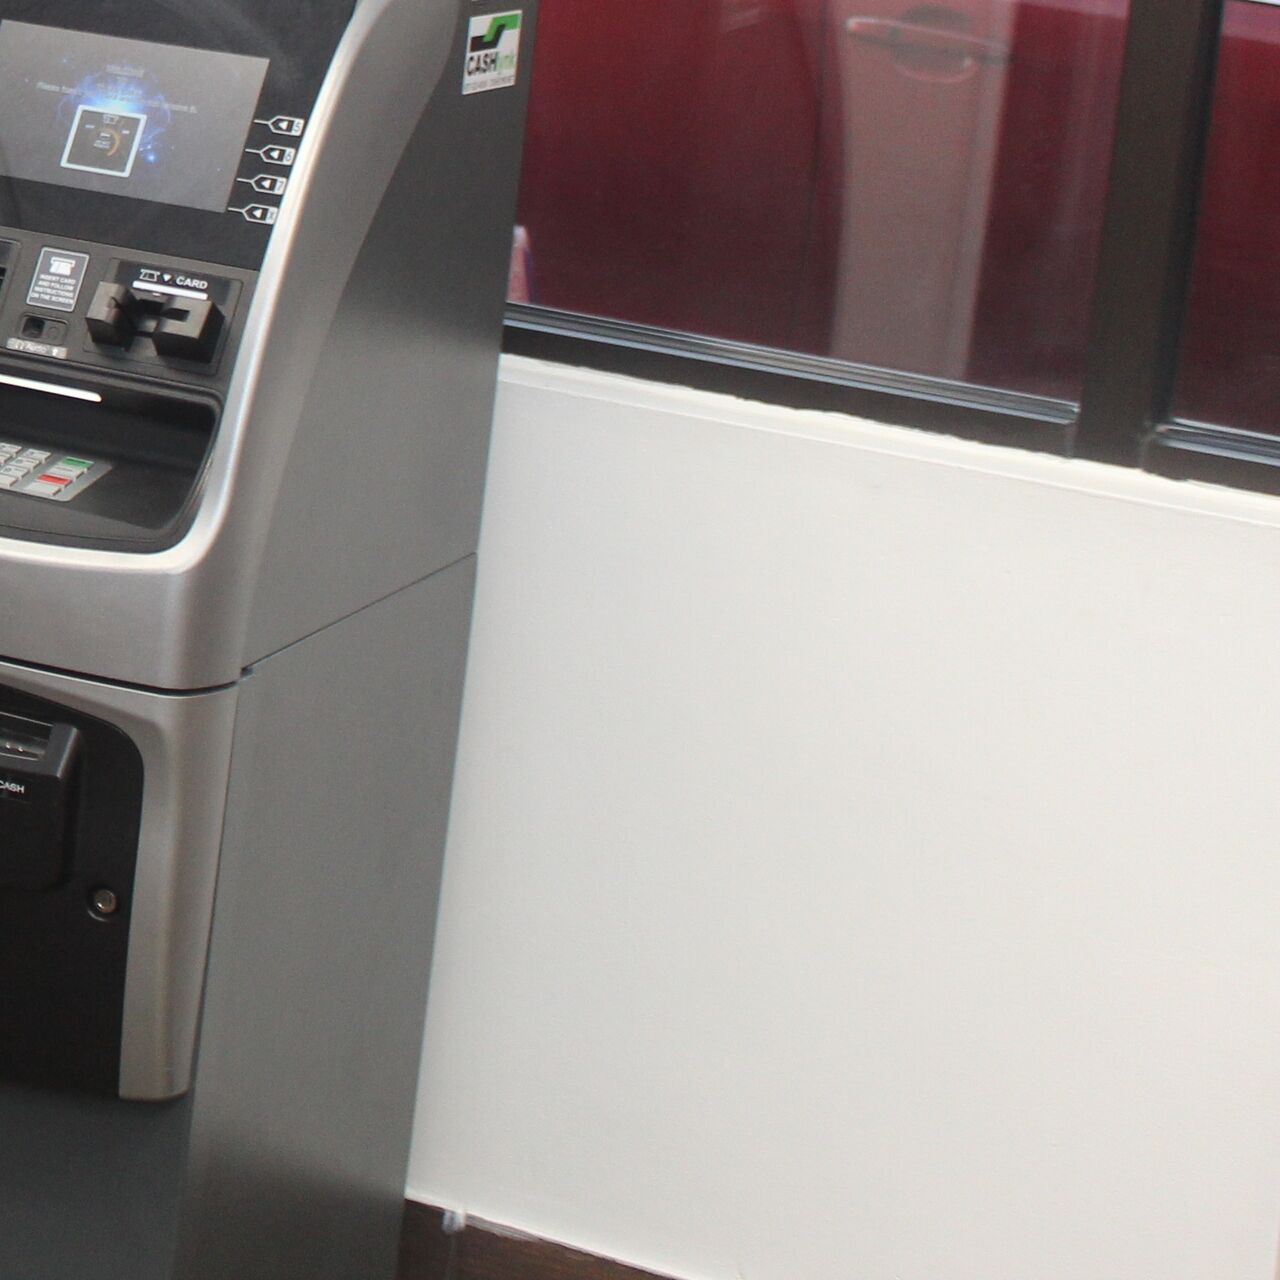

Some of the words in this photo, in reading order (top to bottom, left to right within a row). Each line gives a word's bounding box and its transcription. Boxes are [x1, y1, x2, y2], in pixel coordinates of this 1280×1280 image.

[40, 274, 60, 282] INSERT
[60, 276, 76, 285] CARD
[176, 276, 208, 290] CARD
[34, 286, 74, 298] INSTRUCTIONS
[51, 282, 74, 291] FOLLOW
[51, 295, 75, 304] SCREEN
